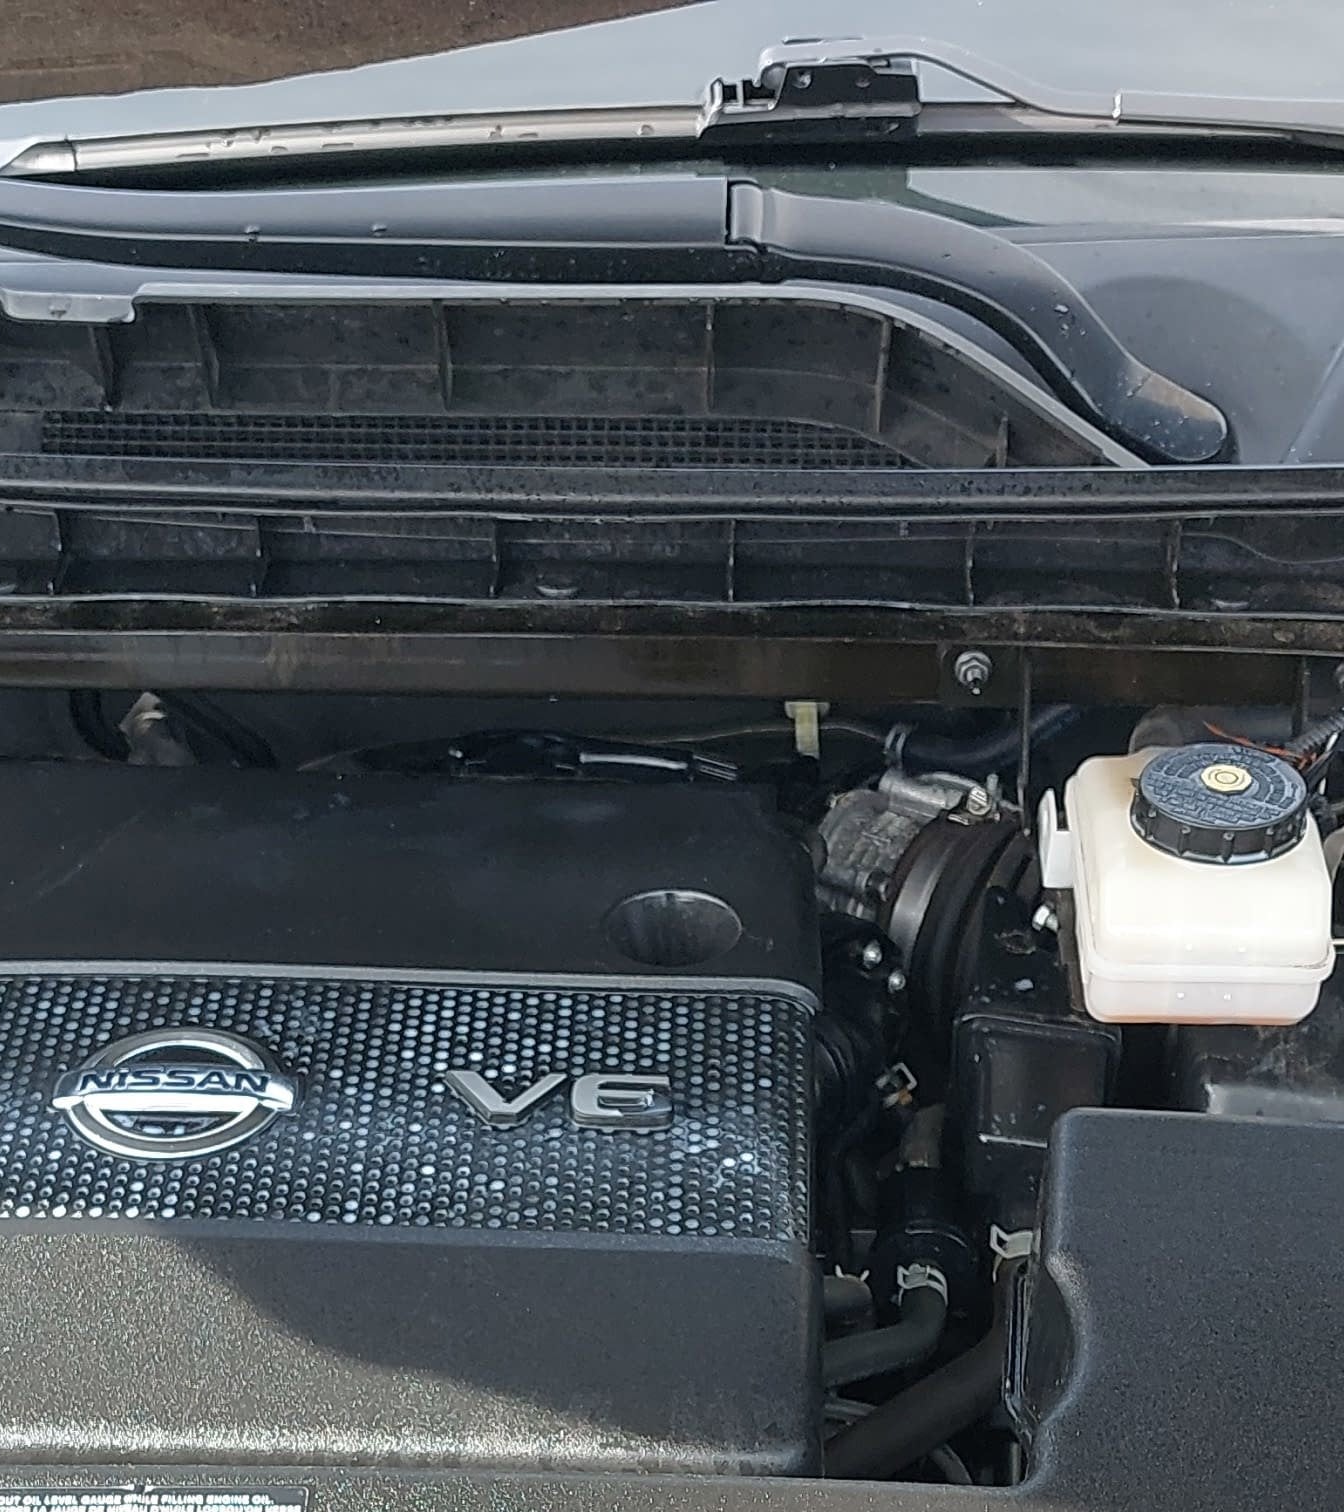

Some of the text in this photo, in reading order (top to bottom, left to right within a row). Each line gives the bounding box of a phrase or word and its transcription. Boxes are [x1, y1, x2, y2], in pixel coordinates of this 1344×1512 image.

[78, 1067, 268, 1092] NISSAN
[444, 1070, 672, 1130] V6
[22, 1495, 41, 1506] OIL
[43, 1495, 79, 1505] LEVEL
[80, 1495, 121, 1505] GAUGE
[123, 1494, 159, 1505] WHILE
[160, 1495, 204, 1505] FILLING
[206, 1495, 249, 1505] ENGINE
[251, 1495, 274, 1505] OIL.
